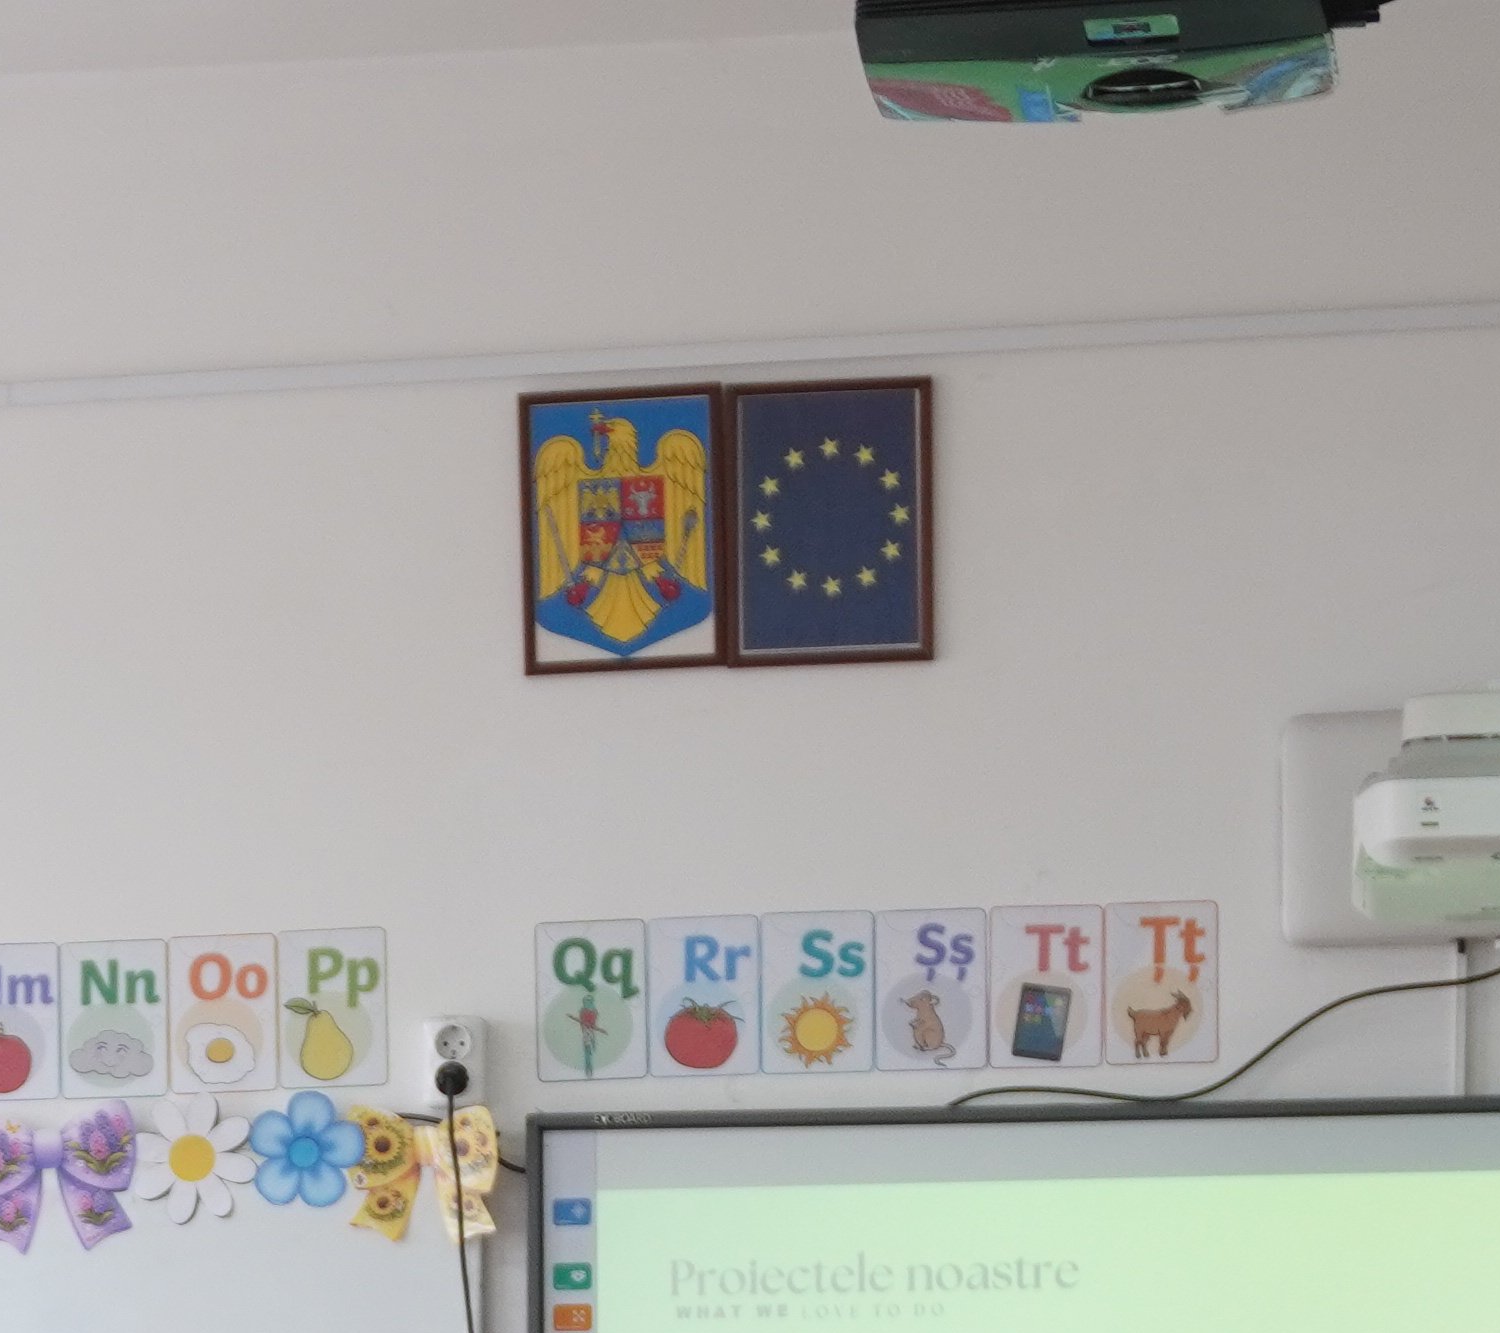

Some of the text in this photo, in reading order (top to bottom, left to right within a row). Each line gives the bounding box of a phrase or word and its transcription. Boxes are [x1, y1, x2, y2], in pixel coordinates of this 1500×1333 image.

[80, 959, 160, 1005] Nn
[189, 952, 269, 1000] Oo
[307, 946, 380, 1007] Pp
[552, 936, 640, 999] Qq
[683, 934, 752, 984] Rr
[800, 929, 866, 979] Ss
[916, 922, 975, 982] Șș
[1025, 924, 1091, 973] Tt
[671, 1252, 1080, 1297] Proiectele noastre
[675, 1305, 743, 1320] WHAT
[757, 1304, 789, 1319] WE
[873, 1303, 903, 1318] TO
[913, 1302, 946, 1317] DO
